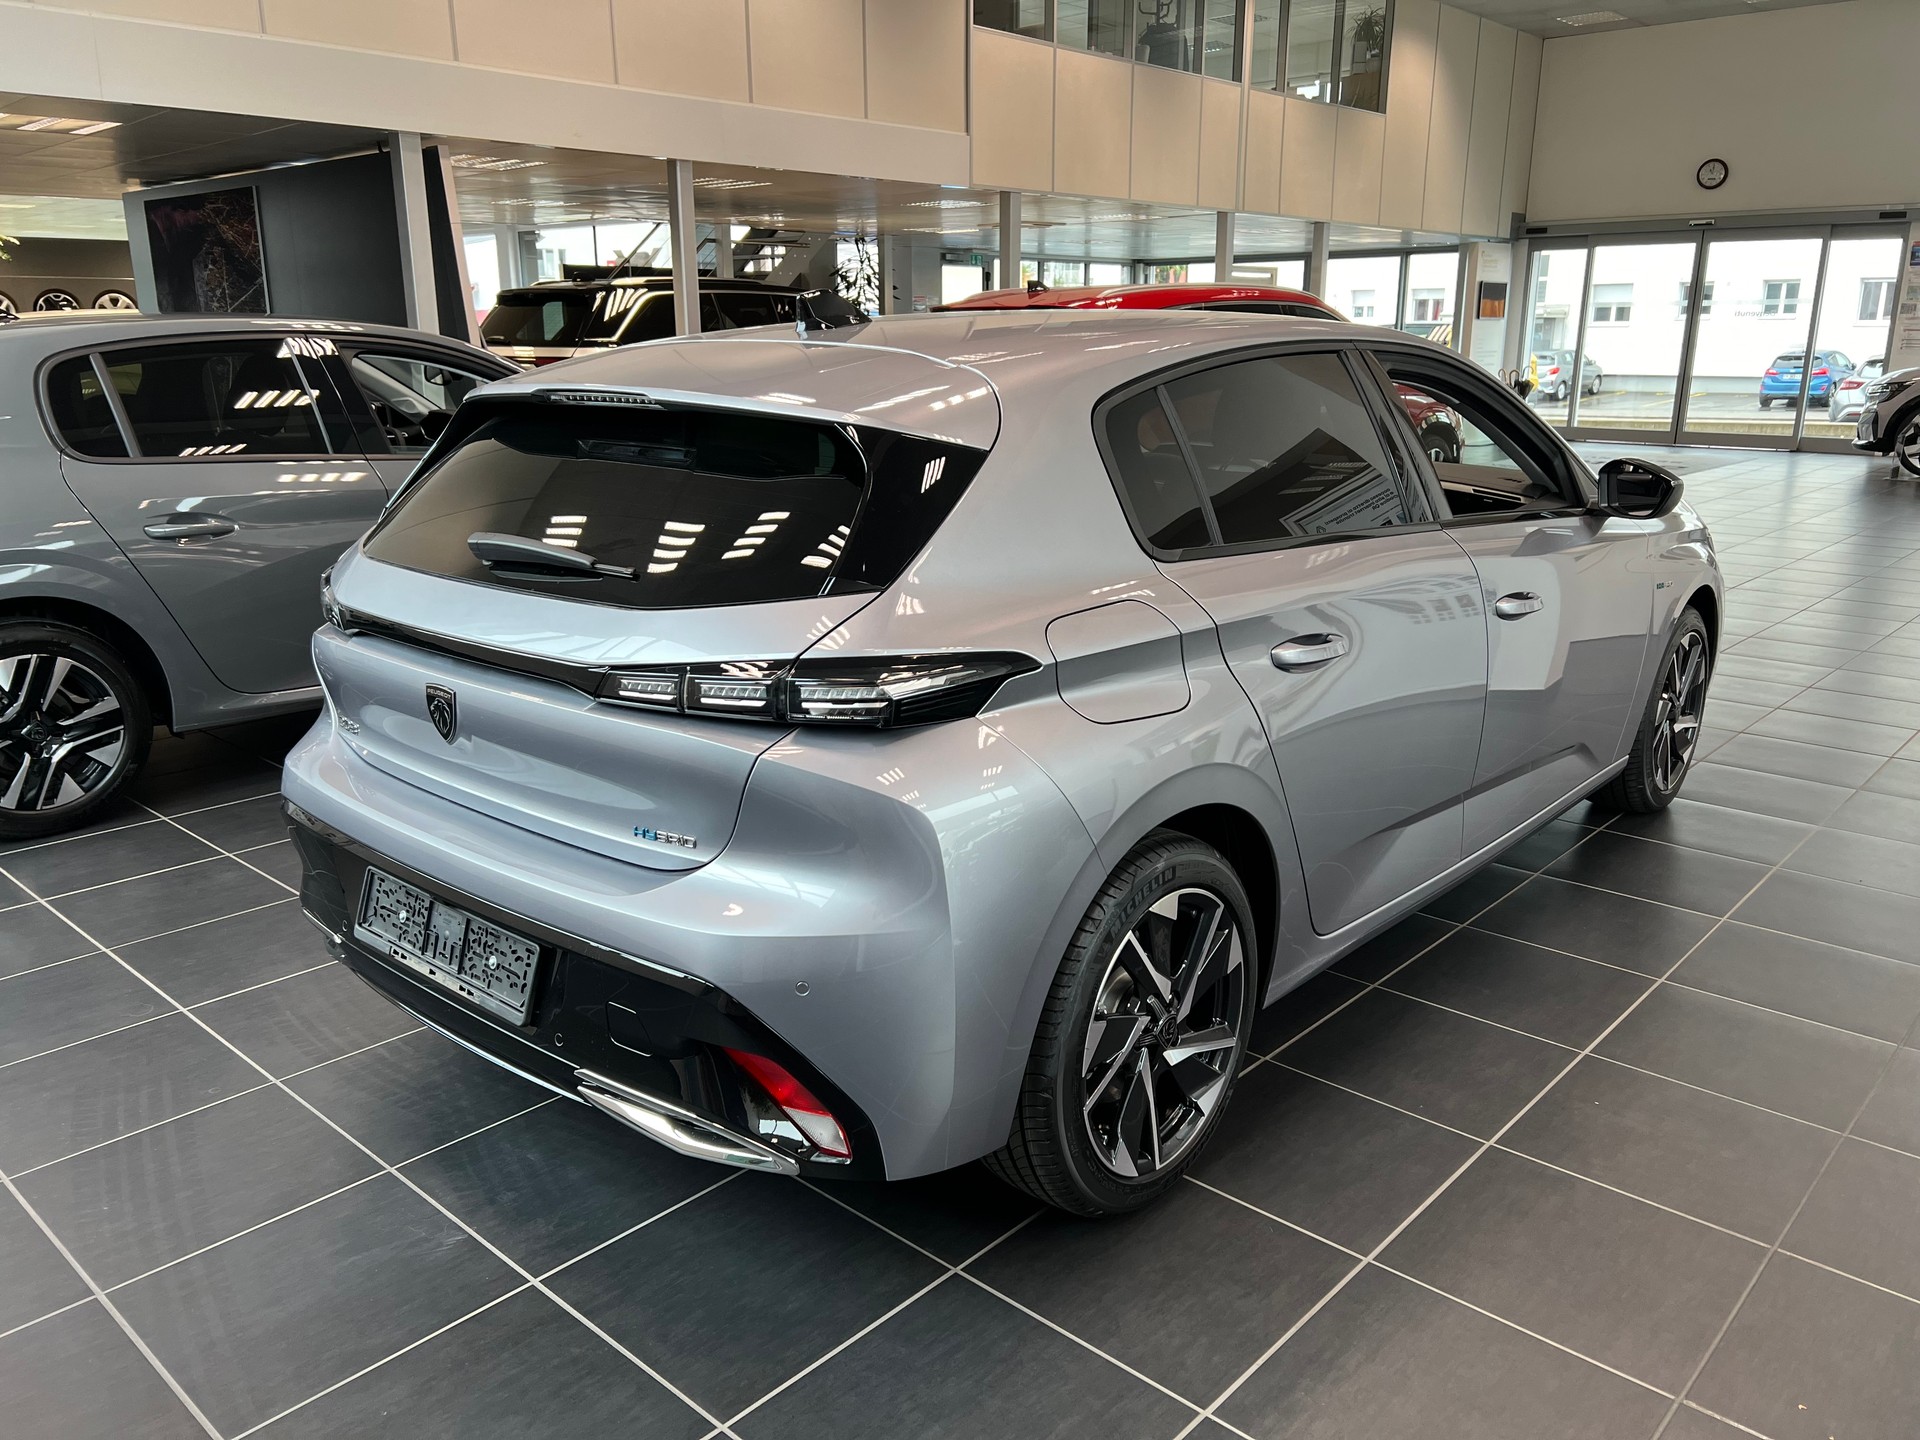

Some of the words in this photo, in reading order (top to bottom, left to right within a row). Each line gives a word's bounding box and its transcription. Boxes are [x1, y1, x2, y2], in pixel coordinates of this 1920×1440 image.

[427, 688, 451, 699] PEUGEOT
[633, 825, 697, 849] HYBRID
[1110, 867, 1173, 938] MICHELIN
